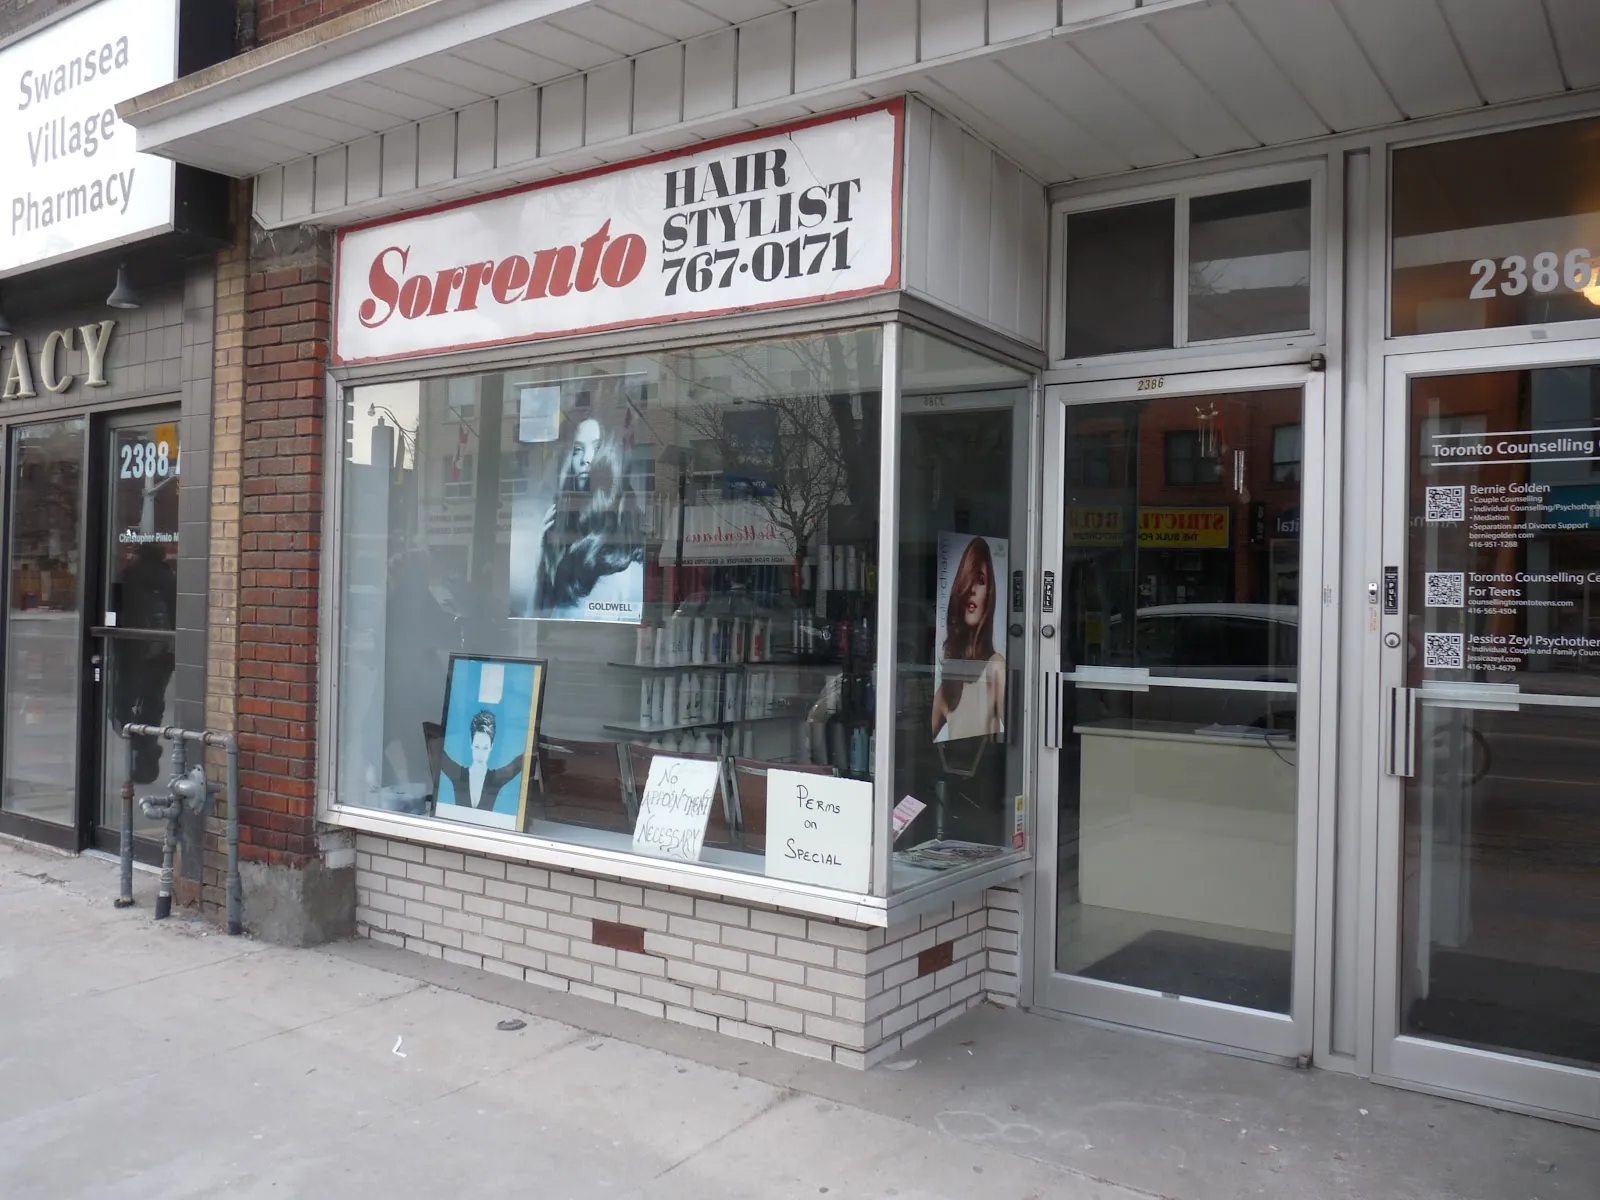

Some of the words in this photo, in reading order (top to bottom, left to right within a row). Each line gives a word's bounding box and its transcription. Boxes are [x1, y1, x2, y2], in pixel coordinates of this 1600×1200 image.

[18, 35, 129, 111] Swansea
[27, 104, 115, 167] Village
[663, 148, 790, 211] HAIR
[11, 168, 136, 237] Pharmacy
[662, 178, 861, 254] STYLIST
[358, 219, 647, 328] Sorrento
[2, 319, 118, 399] ACY
[1137, 377, 1164, 391] 2386
[1432, 443, 1492, 457] Toronto
[1497, 439, 1594, 455] Counselling
[120, 440, 169, 479] 2388
[1470, 485, 1506, 495] Bernie
[1508, 483, 1551, 494] Golden
[1473, 496, 1499, 504] Couple
[1500, 495, 1543, 504] Counselling
[1473, 523, 1512, 531] Separation
[1513, 522, 1527, 530] and
[1528, 522, 1557, 530] Divorce
[1558, 522, 1589, 531] Support
[119, 532, 154, 545] Christopher
[155, 532, 172, 543] Pinto
[1468, 572, 1512, 582] Toronto
[1515, 572, 1584, 585] Counselling
[1468, 586, 1487, 597] For
[1489, 586, 1521, 597] Teens
[588, 602, 632, 612] GOLDWELL
[1467, 634, 1506, 644] Jessica
[1508, 635, 1533, 647] Zeyl
[1535, 635, 1600, 648] Psychother
[1509, 647, 1535, 656] Couple
[1552, 648, 1578, 657] Family
